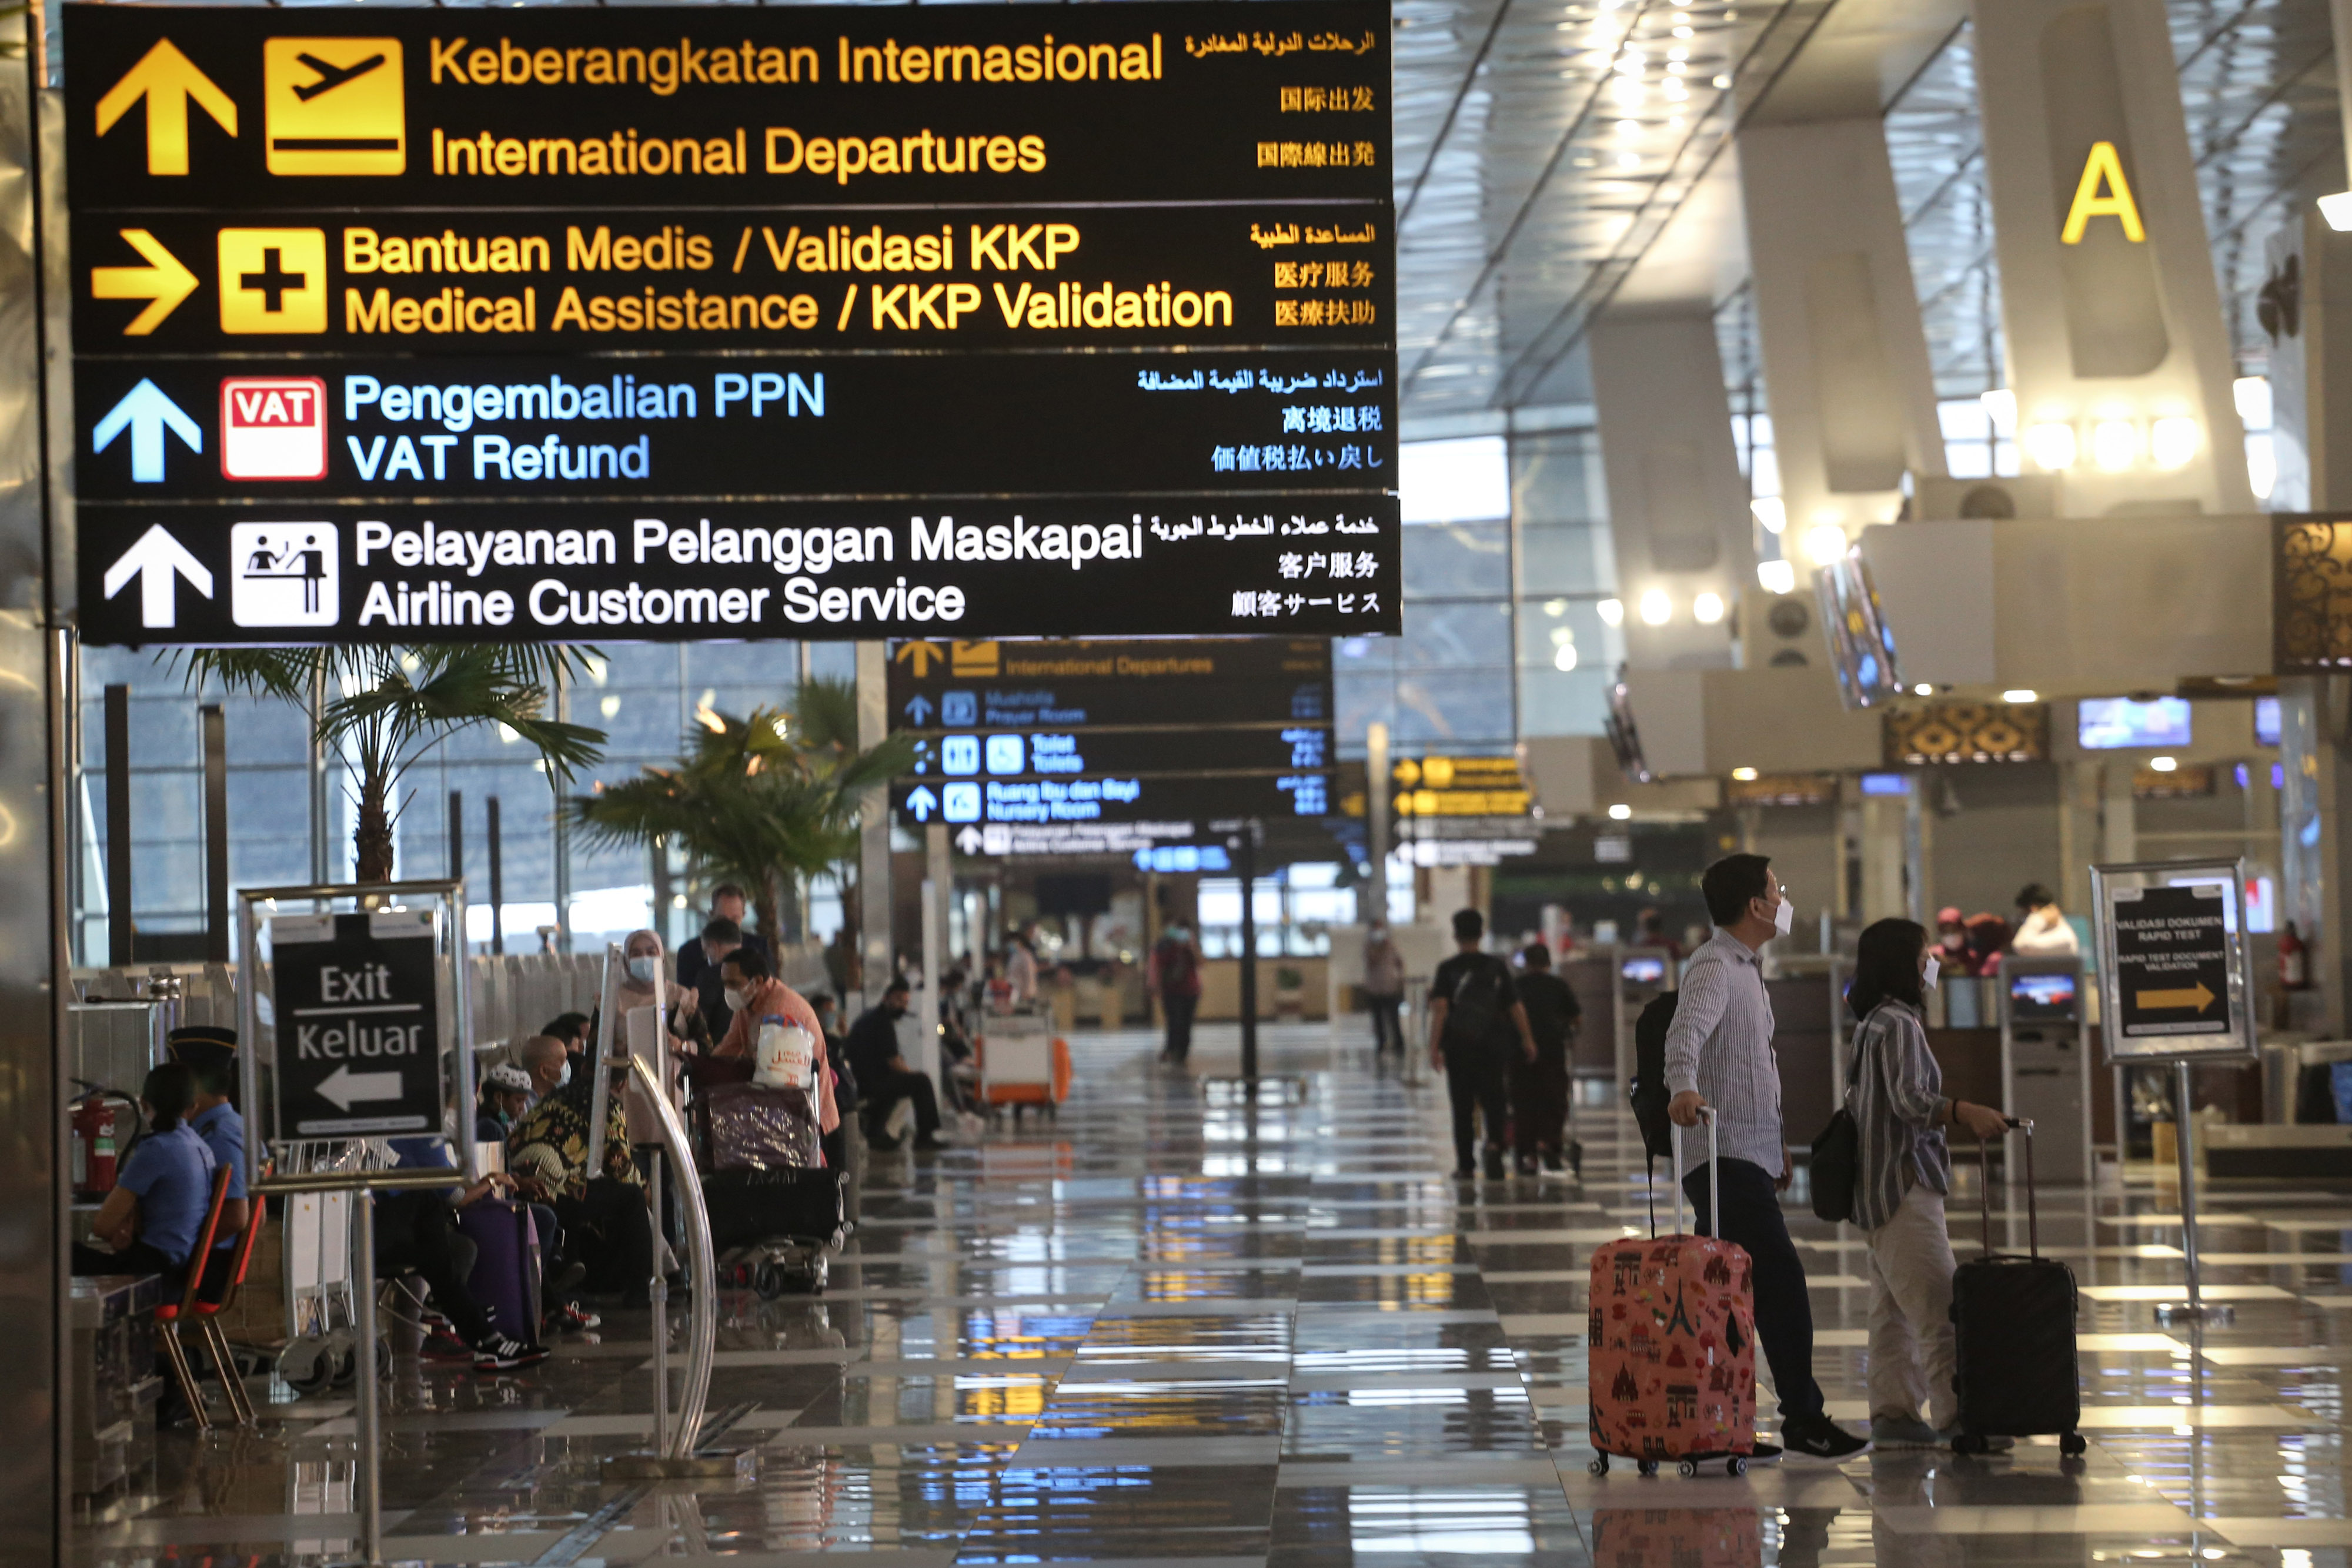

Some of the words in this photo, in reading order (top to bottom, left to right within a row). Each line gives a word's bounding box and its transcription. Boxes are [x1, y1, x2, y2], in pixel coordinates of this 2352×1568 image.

[1185, 33, 1248, 58] المغادرة
[1252, 32, 1302, 56] الدولية
[1308, 32, 1374, 54] الرحلات
[431, 38, 818, 95] Keberangkatan
[839, 32, 1162, 82] Internasional
[1281, 86, 1374, 112] 国际出发
[432, 128, 746, 176] International
[766, 128, 1046, 185] Departures
[1258, 142, 1374, 167] 国際線出発
[2061, 141, 2146, 245] A
[1251, 223, 1299, 249] الطبية
[1305, 223, 1375, 243] المساعدة
[343, 227, 550, 273] Bantuan
[567, 226, 713, 271] Medis
[733, 227, 752, 273] /
[763, 225, 953, 272] Validasi
[971, 223, 1080, 270] KKP
[1275, 261, 1374, 288] 医疗服务
[345, 287, 535, 333] Medical
[552, 286, 818, 331] Assistance
[837, 284, 858, 331] /
[872, 283, 981, 330] KKP
[993, 281, 1232, 329] Validation
[1275, 299, 1375, 326] 医療扶助
[1138, 370, 1204, 390] المضافة
[1209, 369, 1254, 394] القيمة
[1259, 369, 1318, 394] ضريبة
[1323, 369, 1382, 393] استرداد
[235, 390, 312, 423] VAT
[345, 375, 697, 432] Pengembalian
[715, 372, 824, 417] PPN
[1282, 406, 1382, 433] 离境退税
[347, 435, 459, 481] VAT
[473, 434, 649, 480] Refund
[1151, 516, 1203, 541] الجوية
[1207, 514, 1274, 540] الخطوط
[1281, 516, 1329, 536] عملاء
[1335, 514, 1379, 534] خدمة
[357, 521, 616, 577] Pelayanan
[634, 518, 894, 573] Pelanggan
[911, 514, 1142, 570] Maskapai
[1278, 551, 1379, 579] 客户服务
[359, 581, 514, 626] Airline
[529, 579, 770, 625] Customer
[783, 577, 965, 623] Service
[1232, 590, 1379, 617] 顧客サービス
[1007, 660, 1113, 675] International
[1117, 656, 1213, 677] Departures
[1030, 734, 1075, 754] Toilet
[2116, 919, 2165, 930] VALIDASI
[2167, 916, 2223, 928] DOKUMEN
[2139, 931, 2171, 941] RAPID
[2174, 930, 2201, 940] TEST
[2145, 962, 2198, 971] VALIDATION
[321, 963, 390, 1001] Exit
[298, 1020, 422, 1059] Keluar
